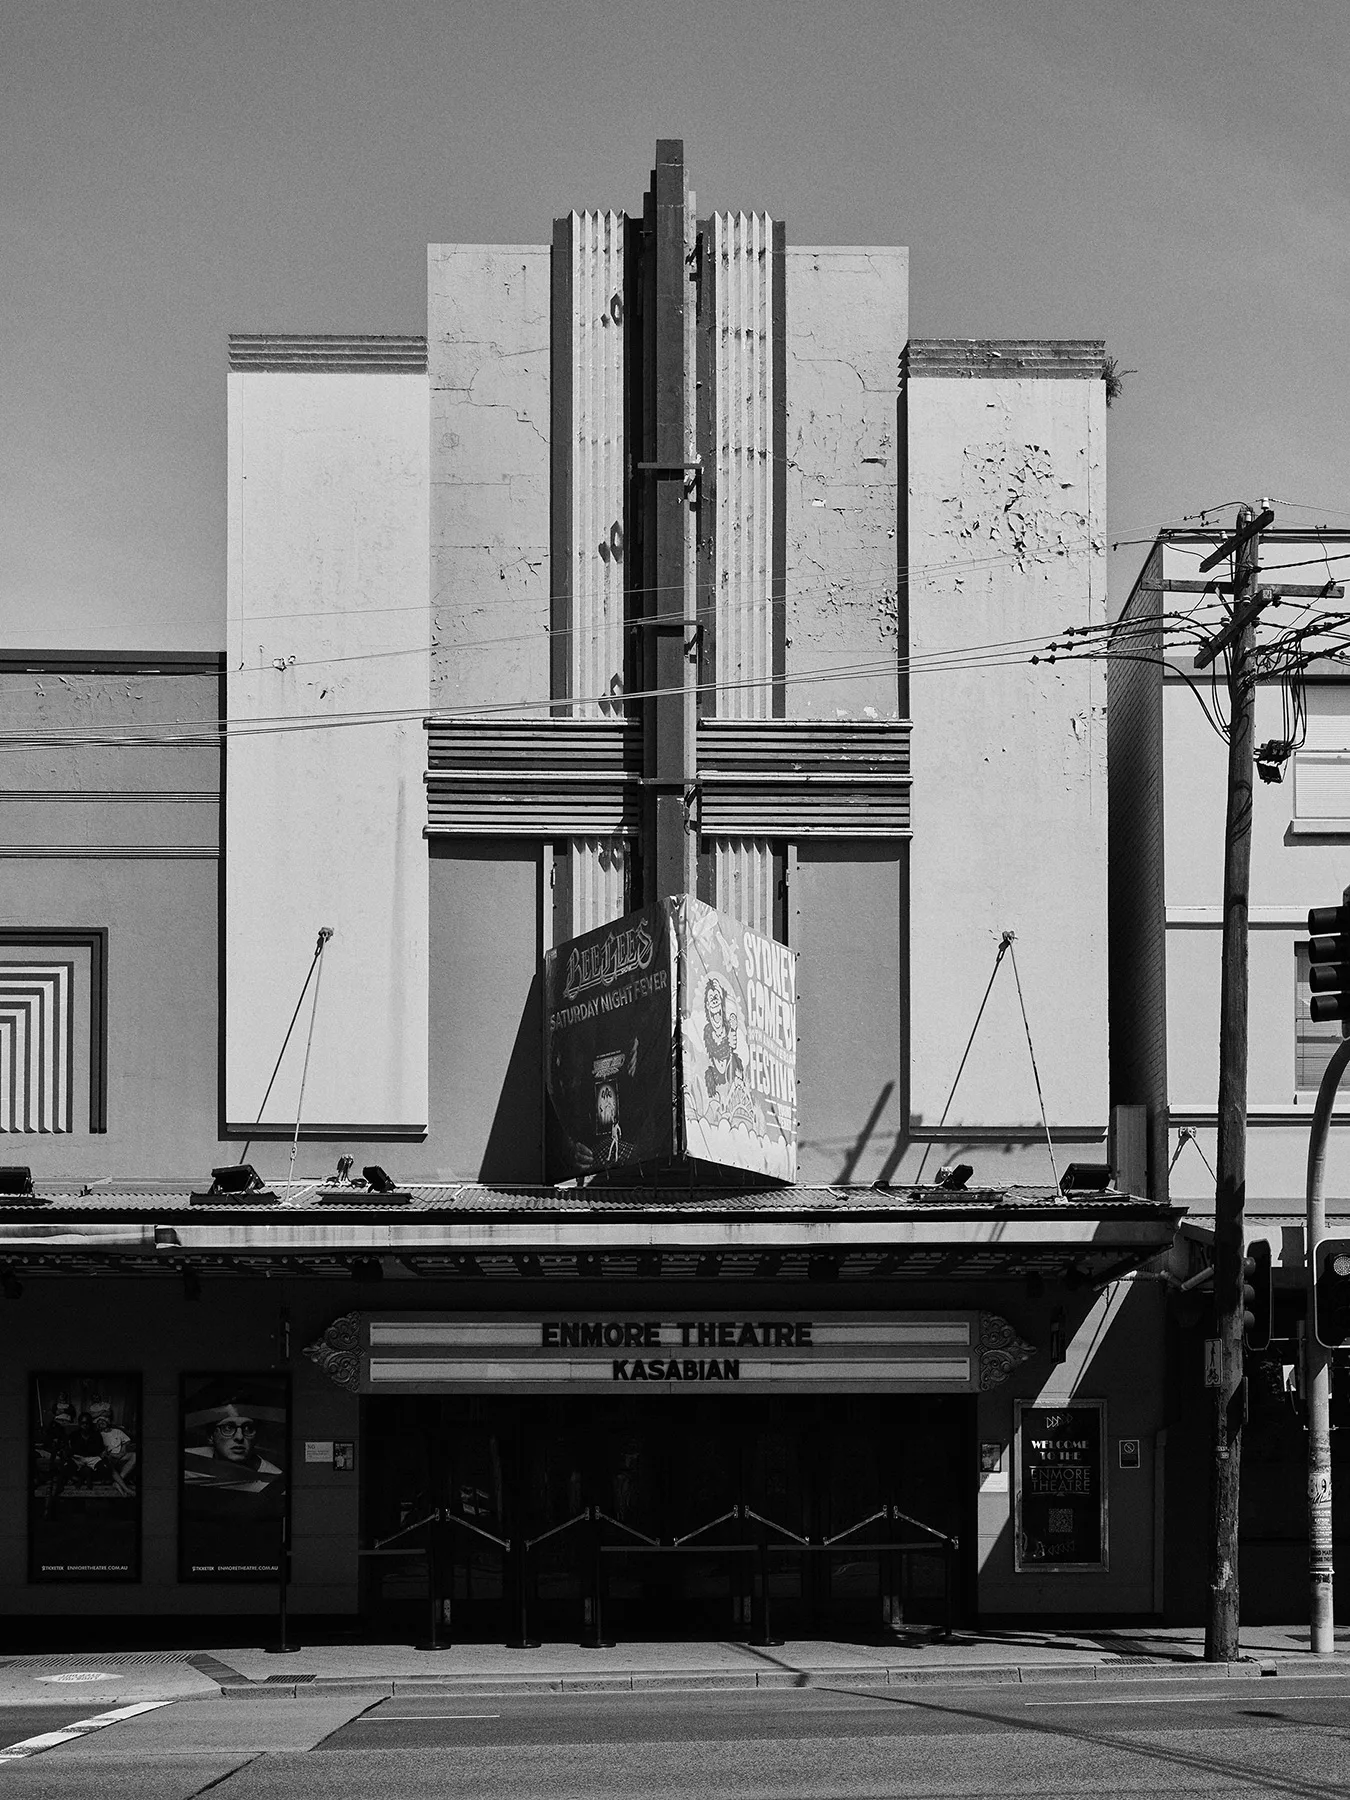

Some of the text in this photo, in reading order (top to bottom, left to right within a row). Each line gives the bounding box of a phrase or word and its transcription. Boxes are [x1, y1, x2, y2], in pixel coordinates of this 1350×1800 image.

[563, 917, 654, 1000] BEE GEES
[743, 931, 796, 1004] SYDNEY
[550, 969, 668, 1032] SATURDAY NIGHT FEVER
[747, 979, 797, 1052] COMEDY
[749, 1043, 797, 1107] FESTIVA
[541, 1322, 813, 1348] ENMORE THEATRE
[612, 1359, 740, 1381] KASABIAN
[1031, 1439, 1090, 1449] WELCOME
[1039, 1451, 1082, 1461] TO THE
[1030, 1468, 1091, 1480] ENMORE
[1030, 1480, 1091, 1492] THEATRE
